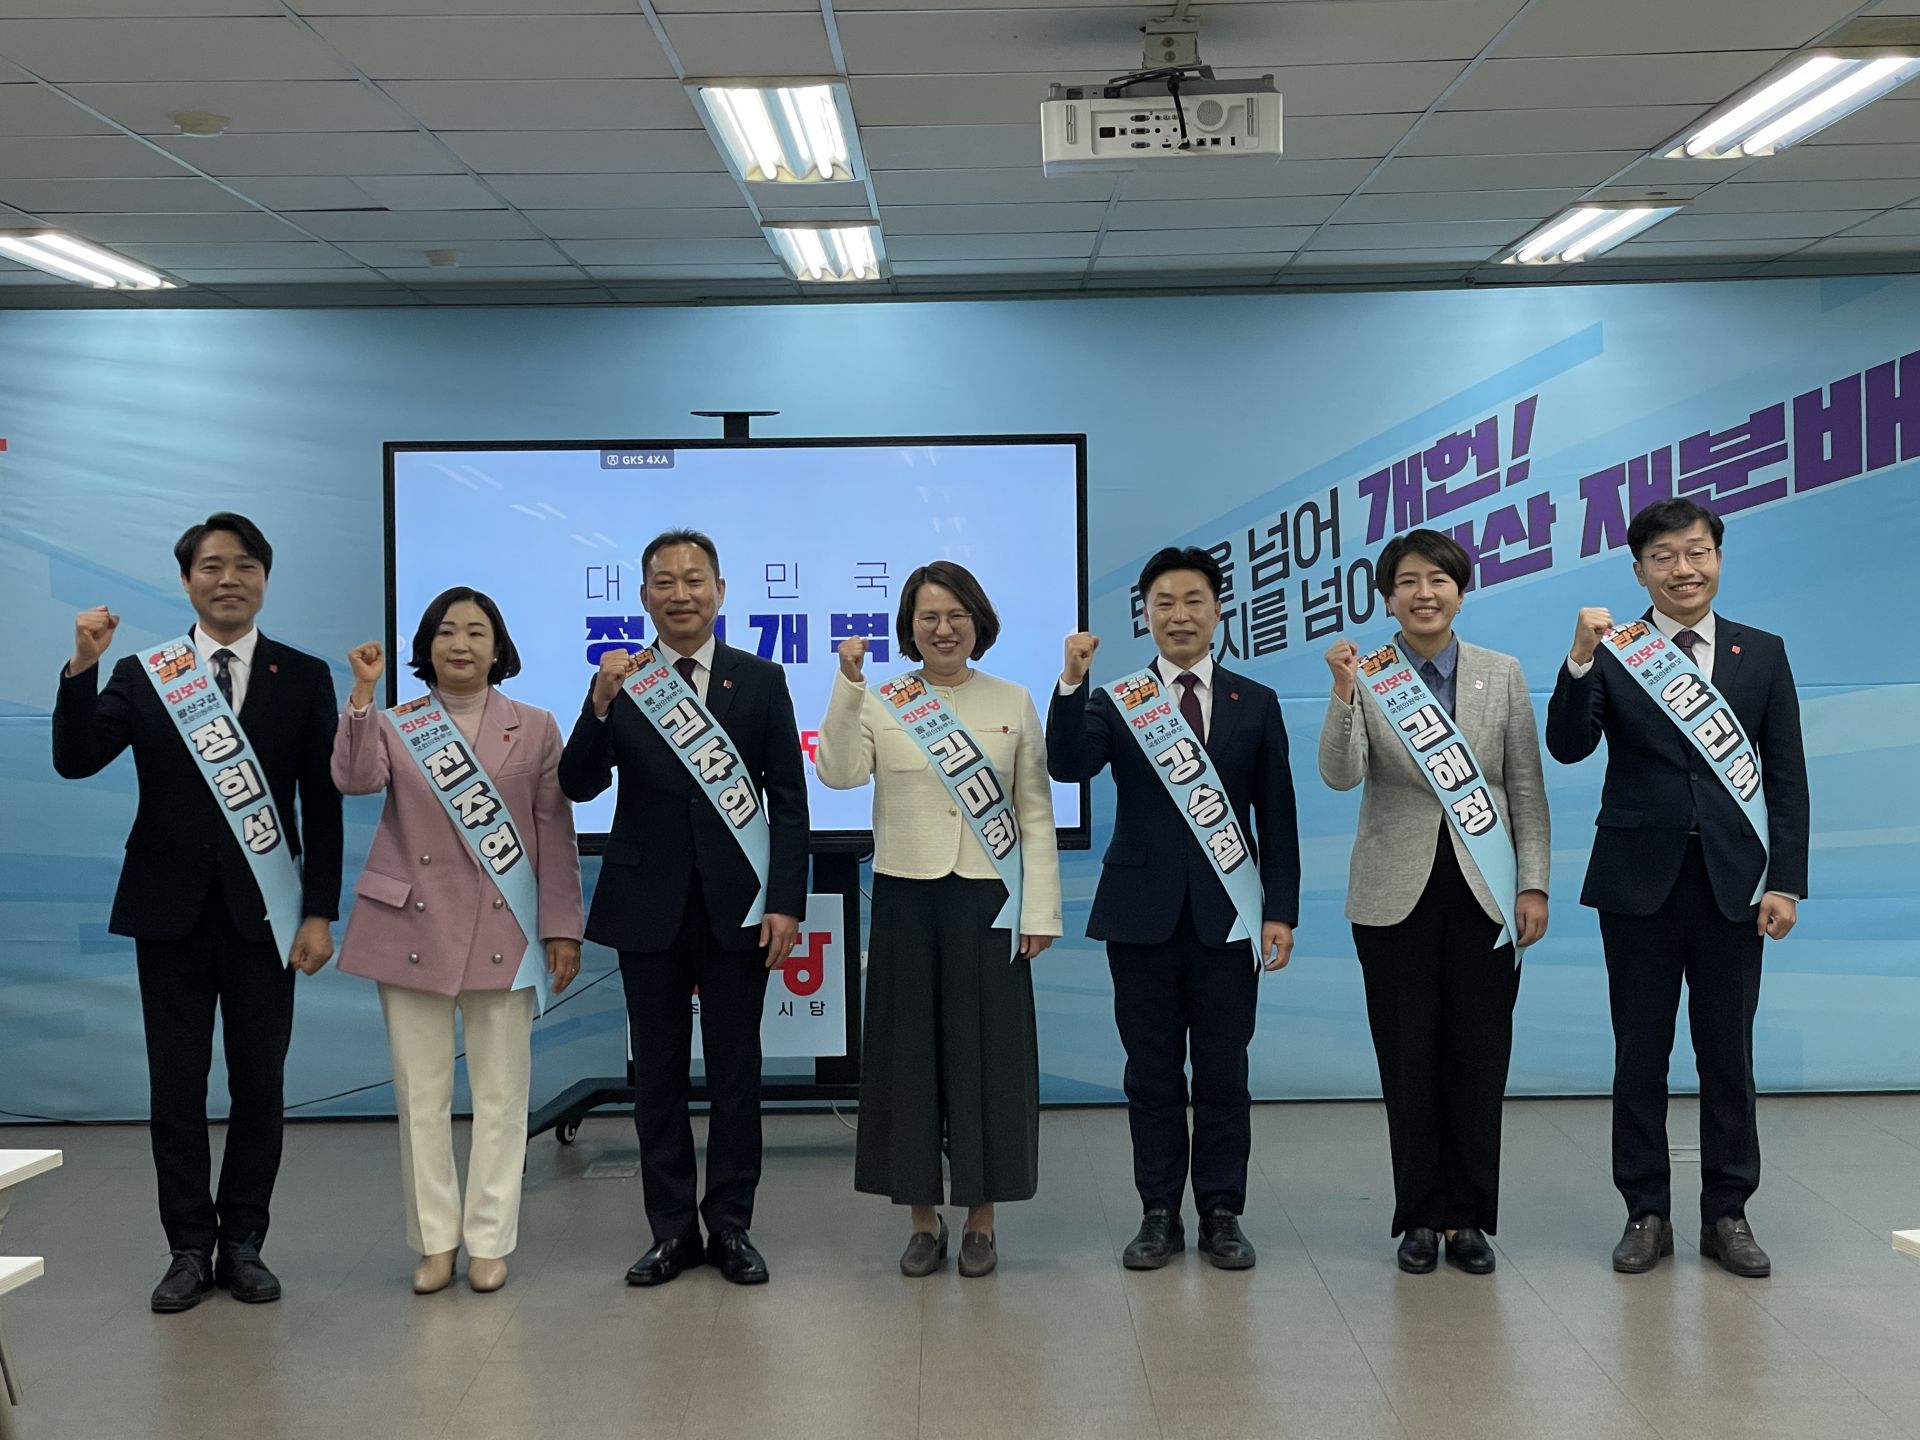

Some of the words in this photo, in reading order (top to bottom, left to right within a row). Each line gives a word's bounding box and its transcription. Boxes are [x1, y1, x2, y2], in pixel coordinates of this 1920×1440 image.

[622, 455, 644, 465] GKS
[646, 455, 669, 465] 4XA
[1247, 486, 1341, 591] 넘어
[1358, 394, 1538, 545] 개헌!
[1210, 588, 1288, 664] 지를
[1580, 350, 1920, 558] 재분배
[166, 675, 208, 704] 진보당
[630, 665, 670, 695] 진보당
[1371, 668, 1413, 695] 진보당
[1625, 637, 1666, 669] 진보당
[177, 692, 217, 719] 광산구갑
[400, 710, 442, 734] 진보당
[901, 698, 941, 724] 진보당
[1131, 701, 1172, 730] 진보당
[1661, 673, 1761, 802] 윤민호
[188, 715, 281, 855] 정희성
[657, 696, 759, 829] 김주업
[927, 729, 1017, 860] 김미화
[1398, 703, 1498, 836] 김해정
[422, 740, 523, 875] 전주연
[1155, 737, 1248, 875] 강승철
